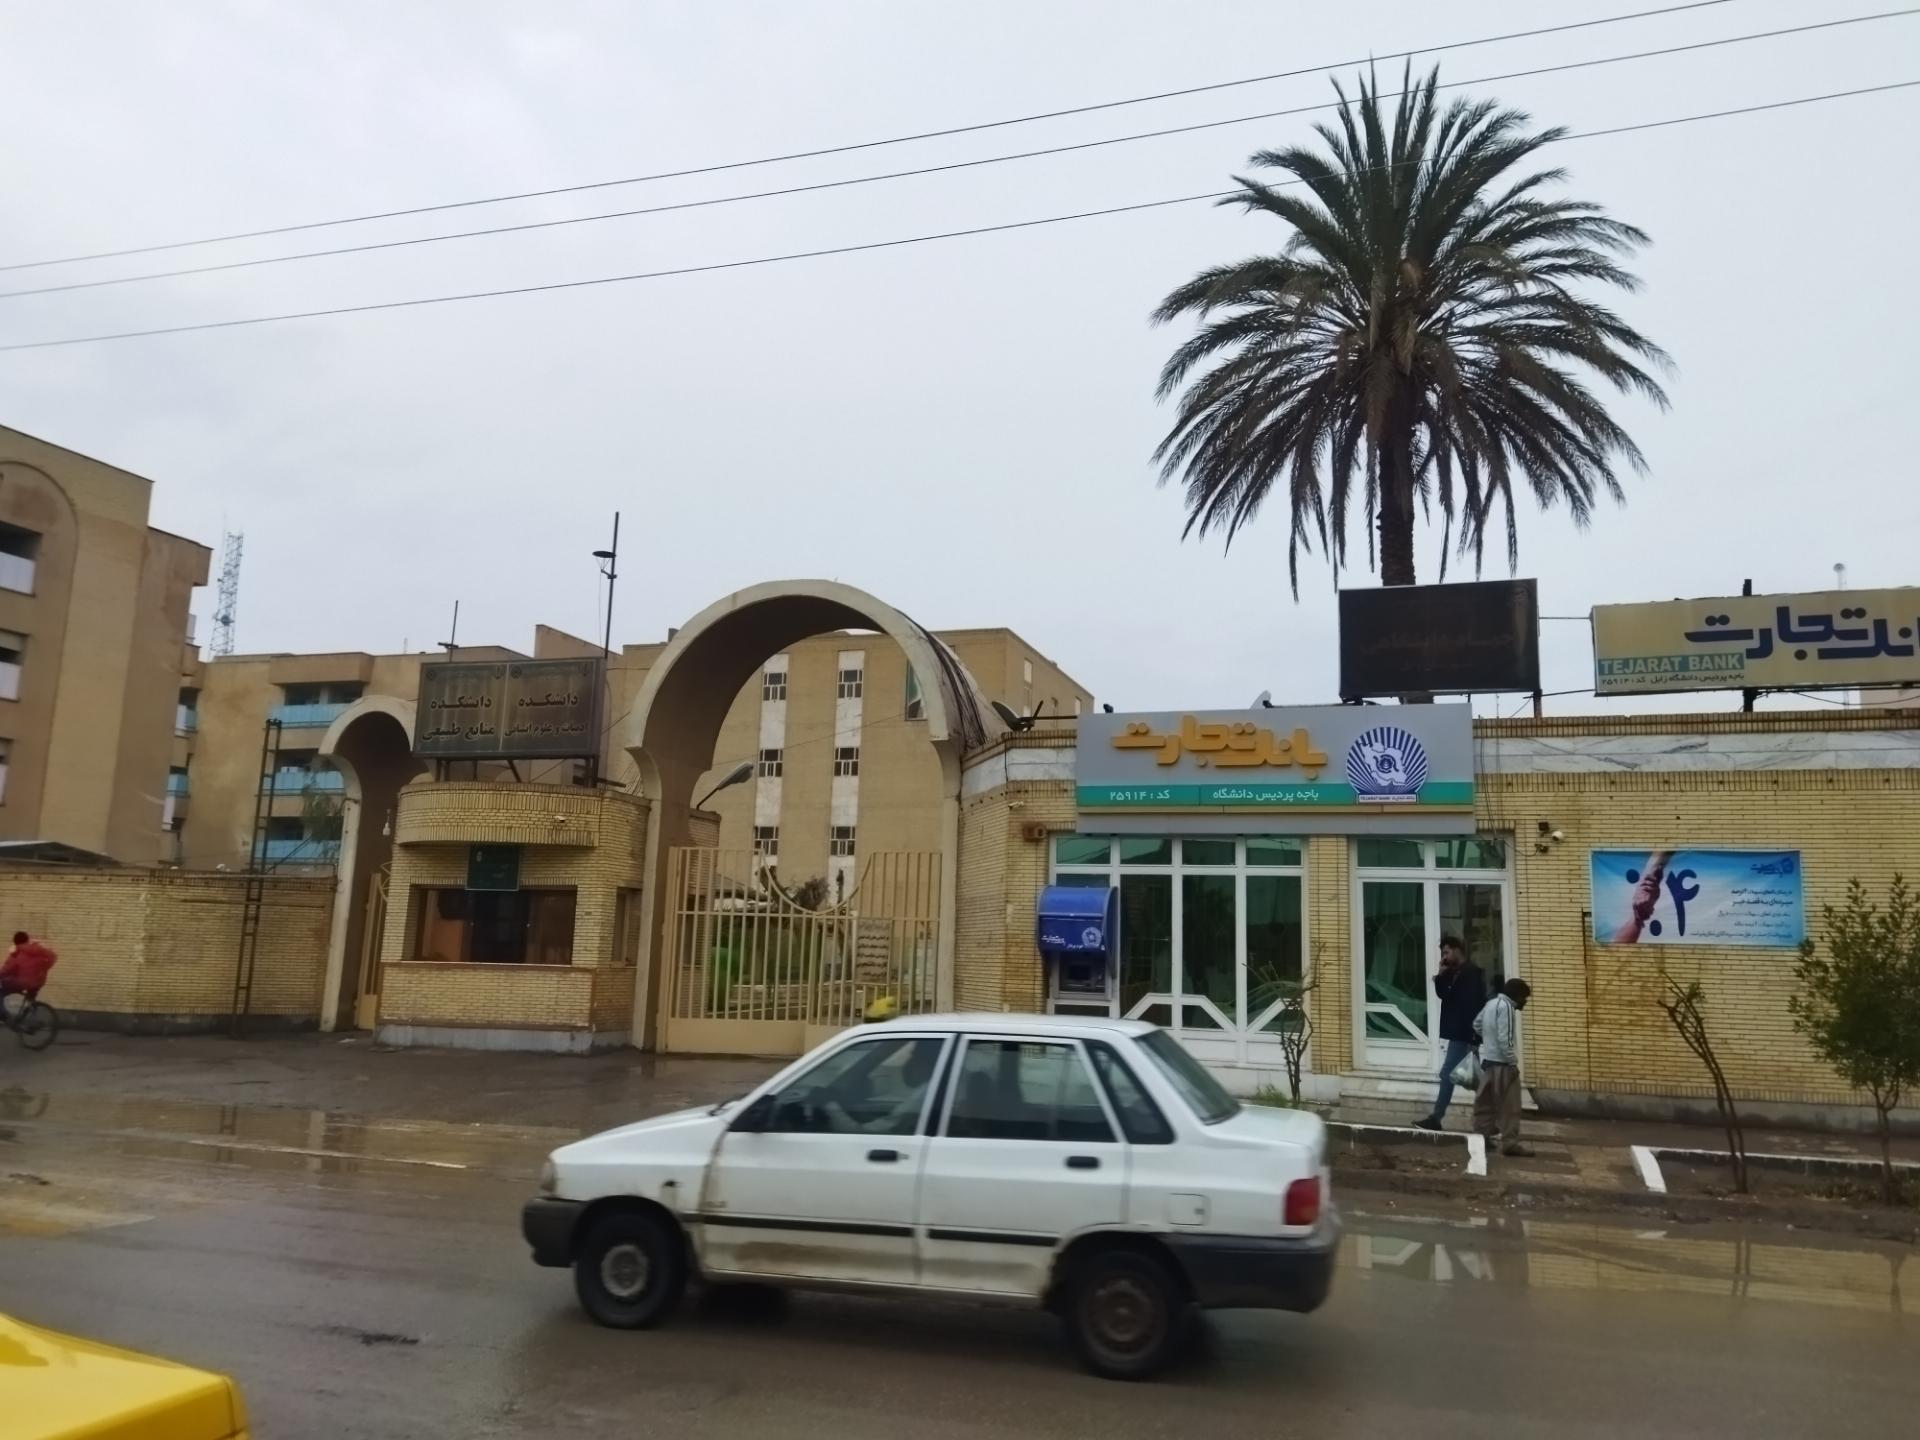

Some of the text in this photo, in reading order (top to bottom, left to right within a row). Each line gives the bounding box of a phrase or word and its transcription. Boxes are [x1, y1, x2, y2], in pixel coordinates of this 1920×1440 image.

[1684, 605, 1869, 661] تجارت
[1601, 654, 1741, 675] TEJARAT BANK
[430, 695, 492, 710] دانشکده
[518, 692, 578, 708] دانشکده
[422, 722, 495, 741] منابع طبیعی
[1111, 714, 1328, 781] بانک تجارت
[1213, 788, 1319, 802] باجه پردیس دانشگاه
